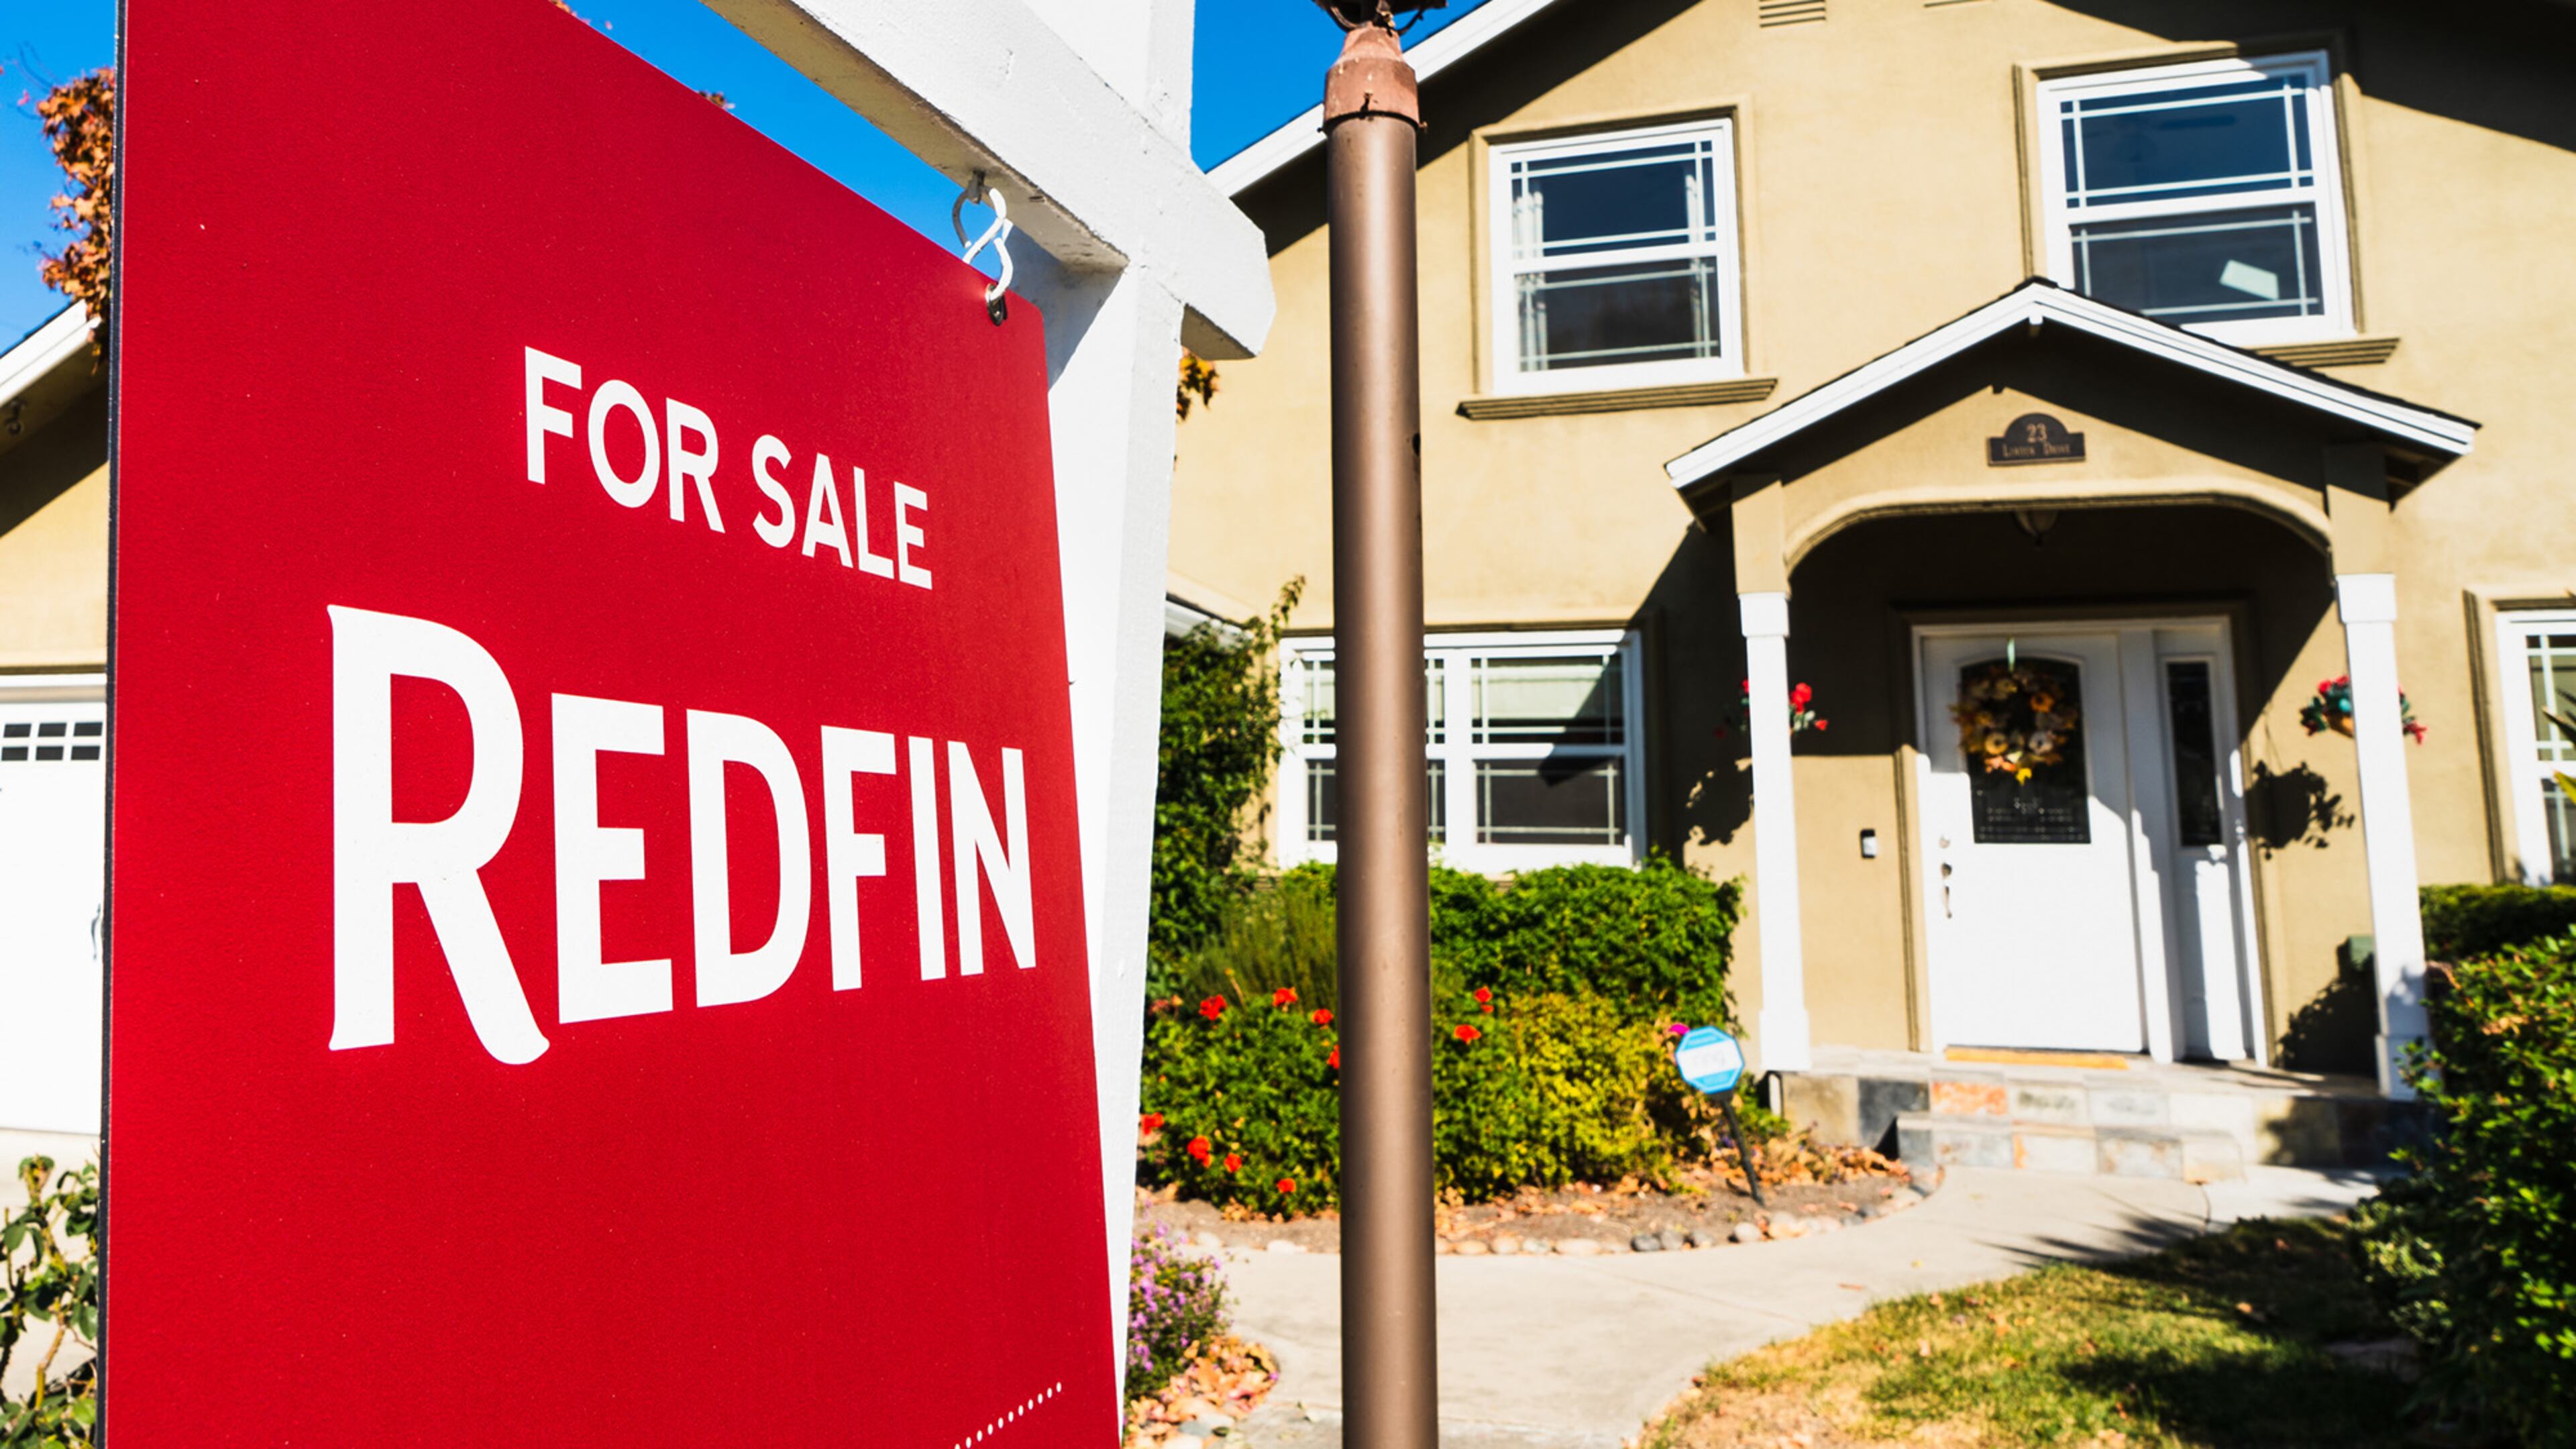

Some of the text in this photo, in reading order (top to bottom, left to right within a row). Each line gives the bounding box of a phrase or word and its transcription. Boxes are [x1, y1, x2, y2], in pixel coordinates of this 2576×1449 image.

[524, 345, 933, 591] FOR SALE
[2026, 423, 2048, 444] 23
[326, 603, 1037, 1066] REDFIN
